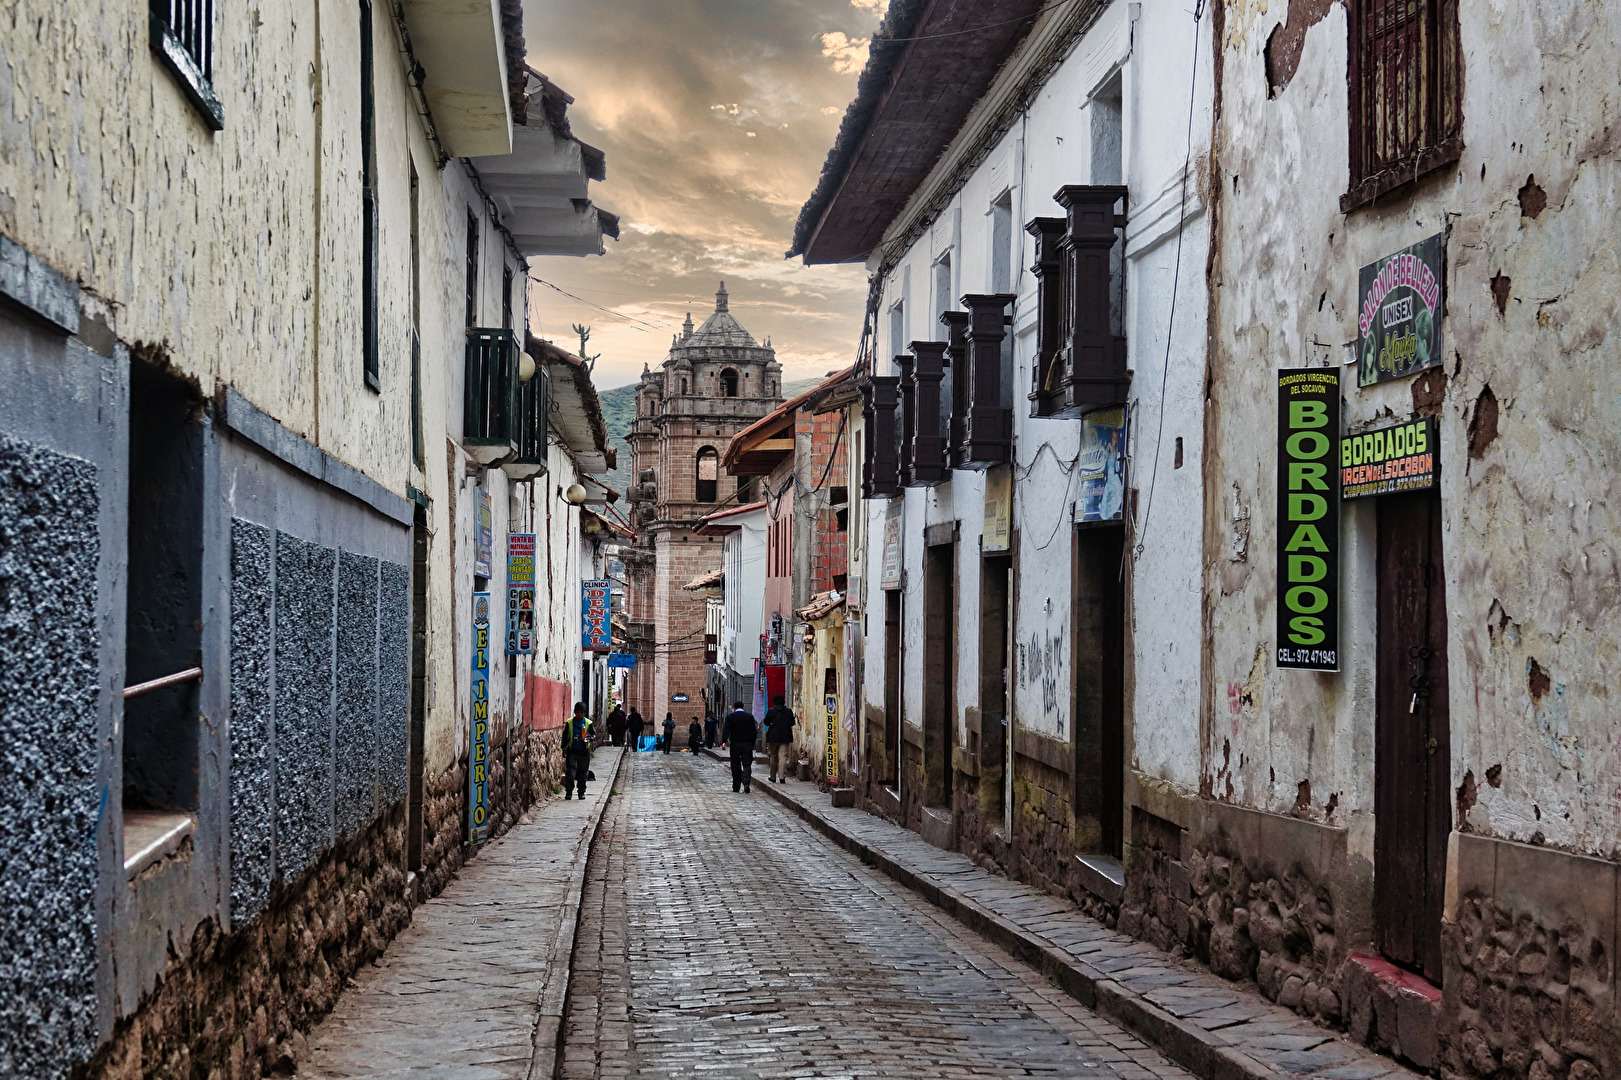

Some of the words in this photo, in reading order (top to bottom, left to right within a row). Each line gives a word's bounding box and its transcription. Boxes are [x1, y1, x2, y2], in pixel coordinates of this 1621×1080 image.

[1359, 267, 1387, 338] SALON
[1386, 255, 1399, 293] DE
[1400, 254, 1439, 318] BELLEZA
[1383, 297, 1412, 327] UNISEX
[1380, 325, 1417, 376] Mayka
[1279, 373, 1306, 387] BORDADOS
[1307, 373, 1338, 385] VIRGENCITA
[1290, 386, 1300, 395] DEL
[1341, 421, 1427, 467] BORDADOS
[1385, 453, 1433, 479] SOCABON
[1378, 480, 1388, 493] 231
[1284, 400, 1330, 645] BORDADOS
[509, 565, 535, 573] PRENSADO
[509, 589, 517, 651] COPIAS
[588, 590, 606, 645] DENTAL
[476, 629, 487, 669] EL
[1297, 649, 1309, 663] 972
[1310, 650, 1336, 664] 471943
[473, 679, 488, 825] IMPERIO
